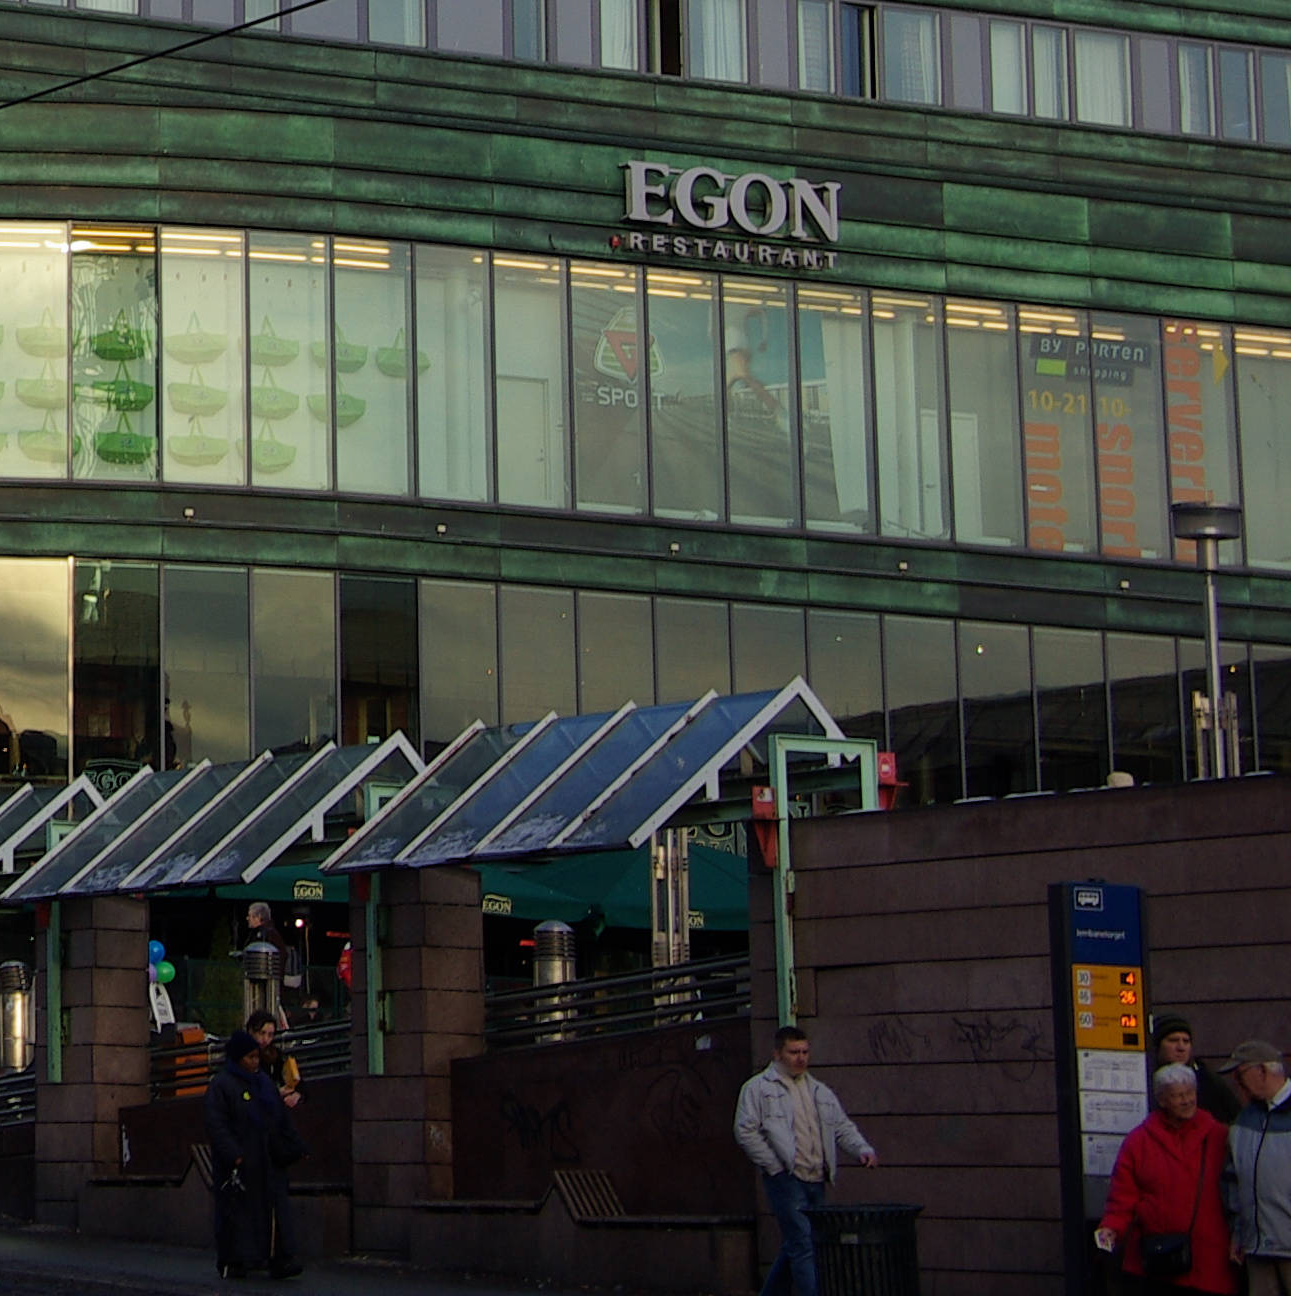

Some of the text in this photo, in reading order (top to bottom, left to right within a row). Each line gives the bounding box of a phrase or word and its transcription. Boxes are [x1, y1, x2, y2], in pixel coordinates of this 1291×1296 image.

[620, 160, 843, 243] EGON
[628, 231, 838, 270] RESTAURANT
[1073, 364, 1127, 381] shpping
[597, 386, 666, 411] SPOT
